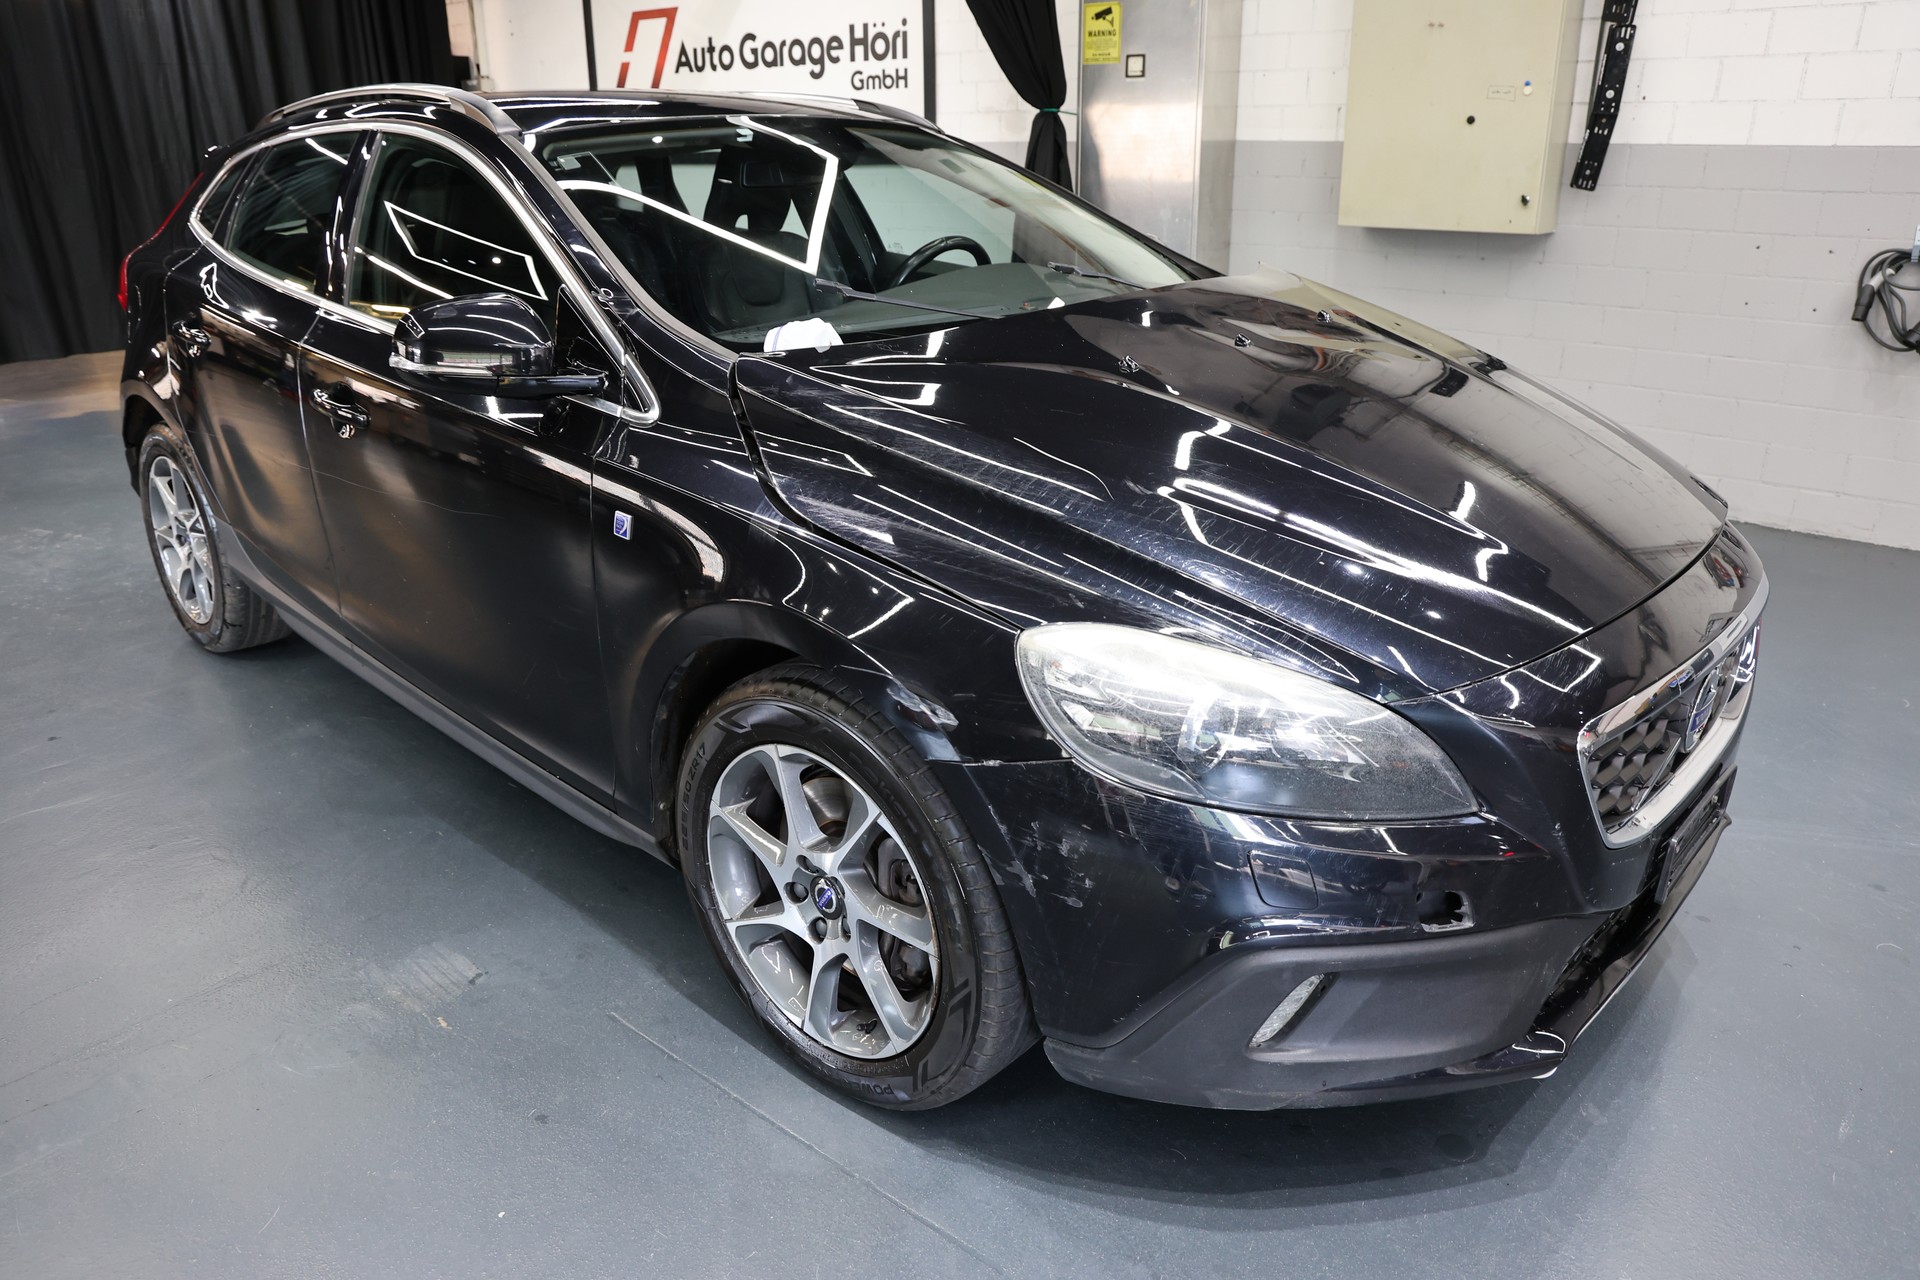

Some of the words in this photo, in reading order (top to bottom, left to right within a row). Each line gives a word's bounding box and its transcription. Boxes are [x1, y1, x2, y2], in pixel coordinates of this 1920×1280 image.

[1088, 29, 1117, 37] WARNING
[675, 37, 735, 74] Auto
[739, 33, 844, 79] Garage
[849, 18, 908, 62] Höri
[850, 68, 908, 91] GmbH
